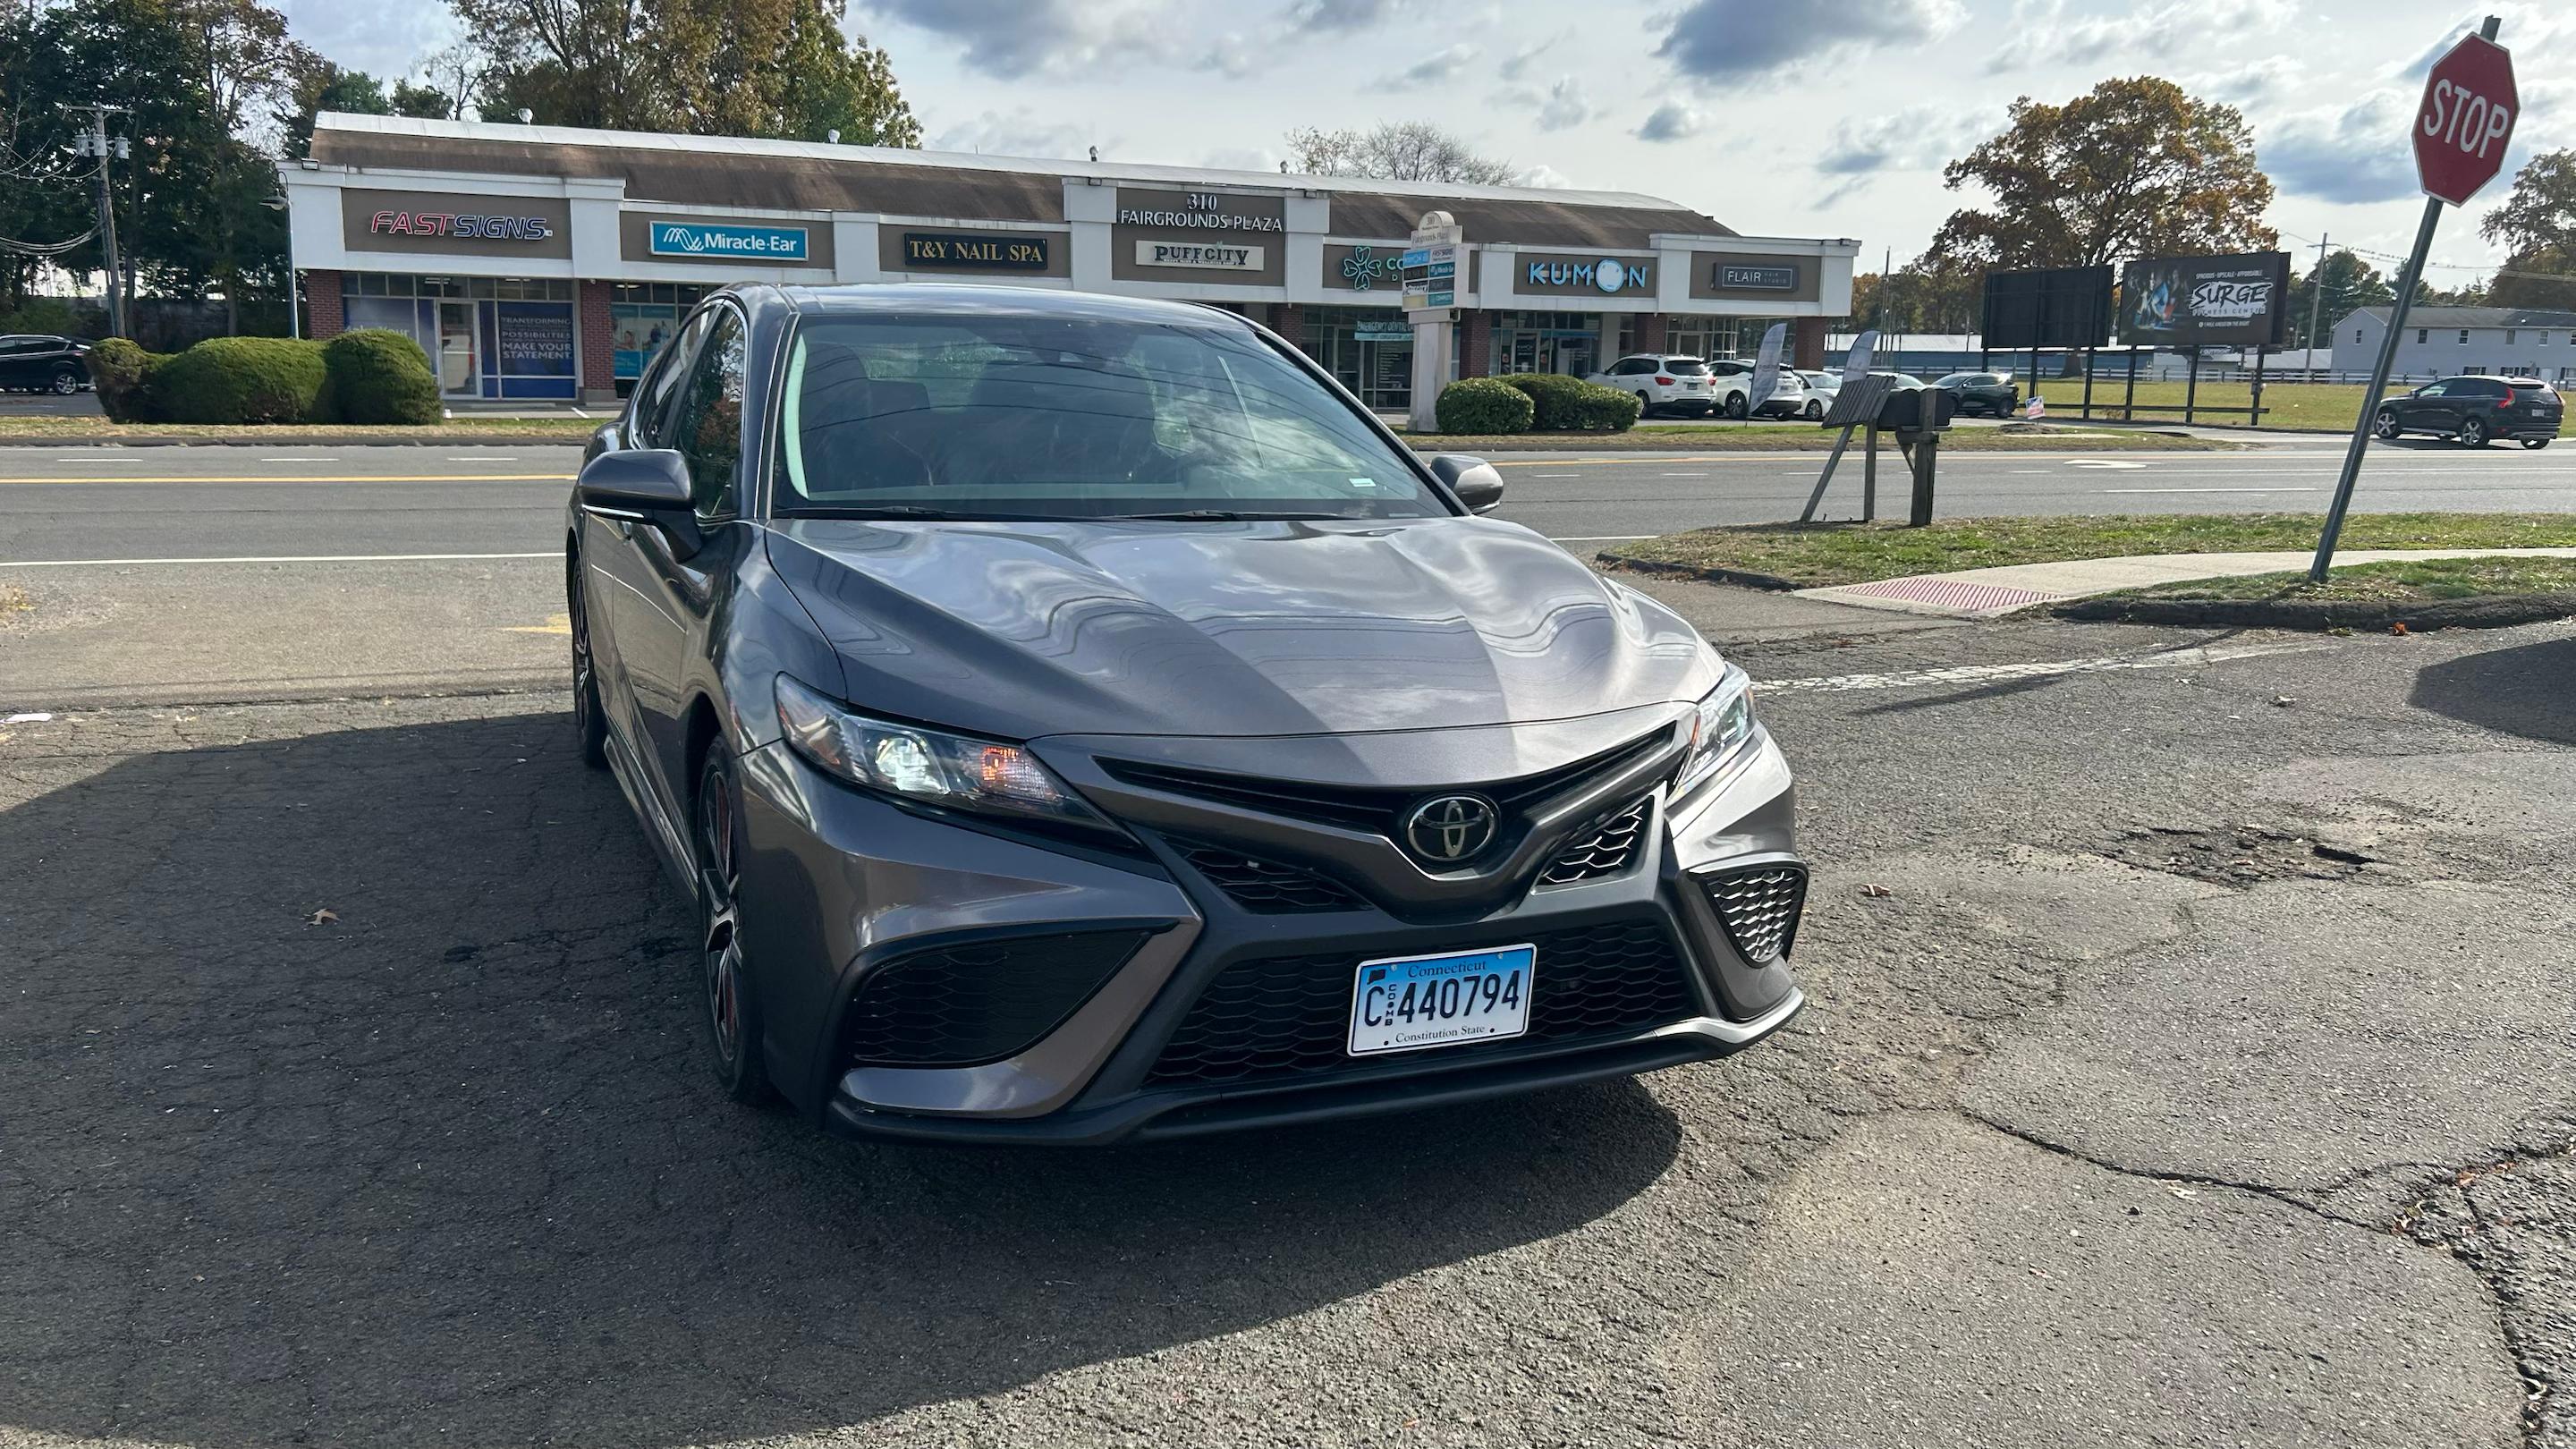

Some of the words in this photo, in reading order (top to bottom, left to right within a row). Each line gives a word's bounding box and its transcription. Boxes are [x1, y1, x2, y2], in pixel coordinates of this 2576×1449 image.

[2423, 78, 2509, 159] STOP
[1187, 193, 1217, 211] 310
[371, 211, 548, 241] FASTSIGNS
[1121, 209, 1228, 229] FAIRGROUNDS
[1233, 216, 1283, 233] PLAZA
[704, 232, 798, 252] Miracle-Ear
[909, 240, 949, 258] T&Y
[955, 242, 1003, 261] NAIL
[1009, 244, 1043, 263] SPA
[1528, 258, 1648, 293] KUMON
[1727, 270, 1761, 283] FLAIR
[2191, 283, 2272, 308] SURGE
[500, 316, 572, 326] TRANSFORMING
[502, 331, 572, 340] POSSIBILITIES
[503, 342, 537, 352] MAKE
[538, 342, 572, 352] YOUR
[1408, 961, 1487, 978] Connecticut
[1395, 1029, 1458, 1044] Constitution
[1462, 1024, 1486, 1035] State
